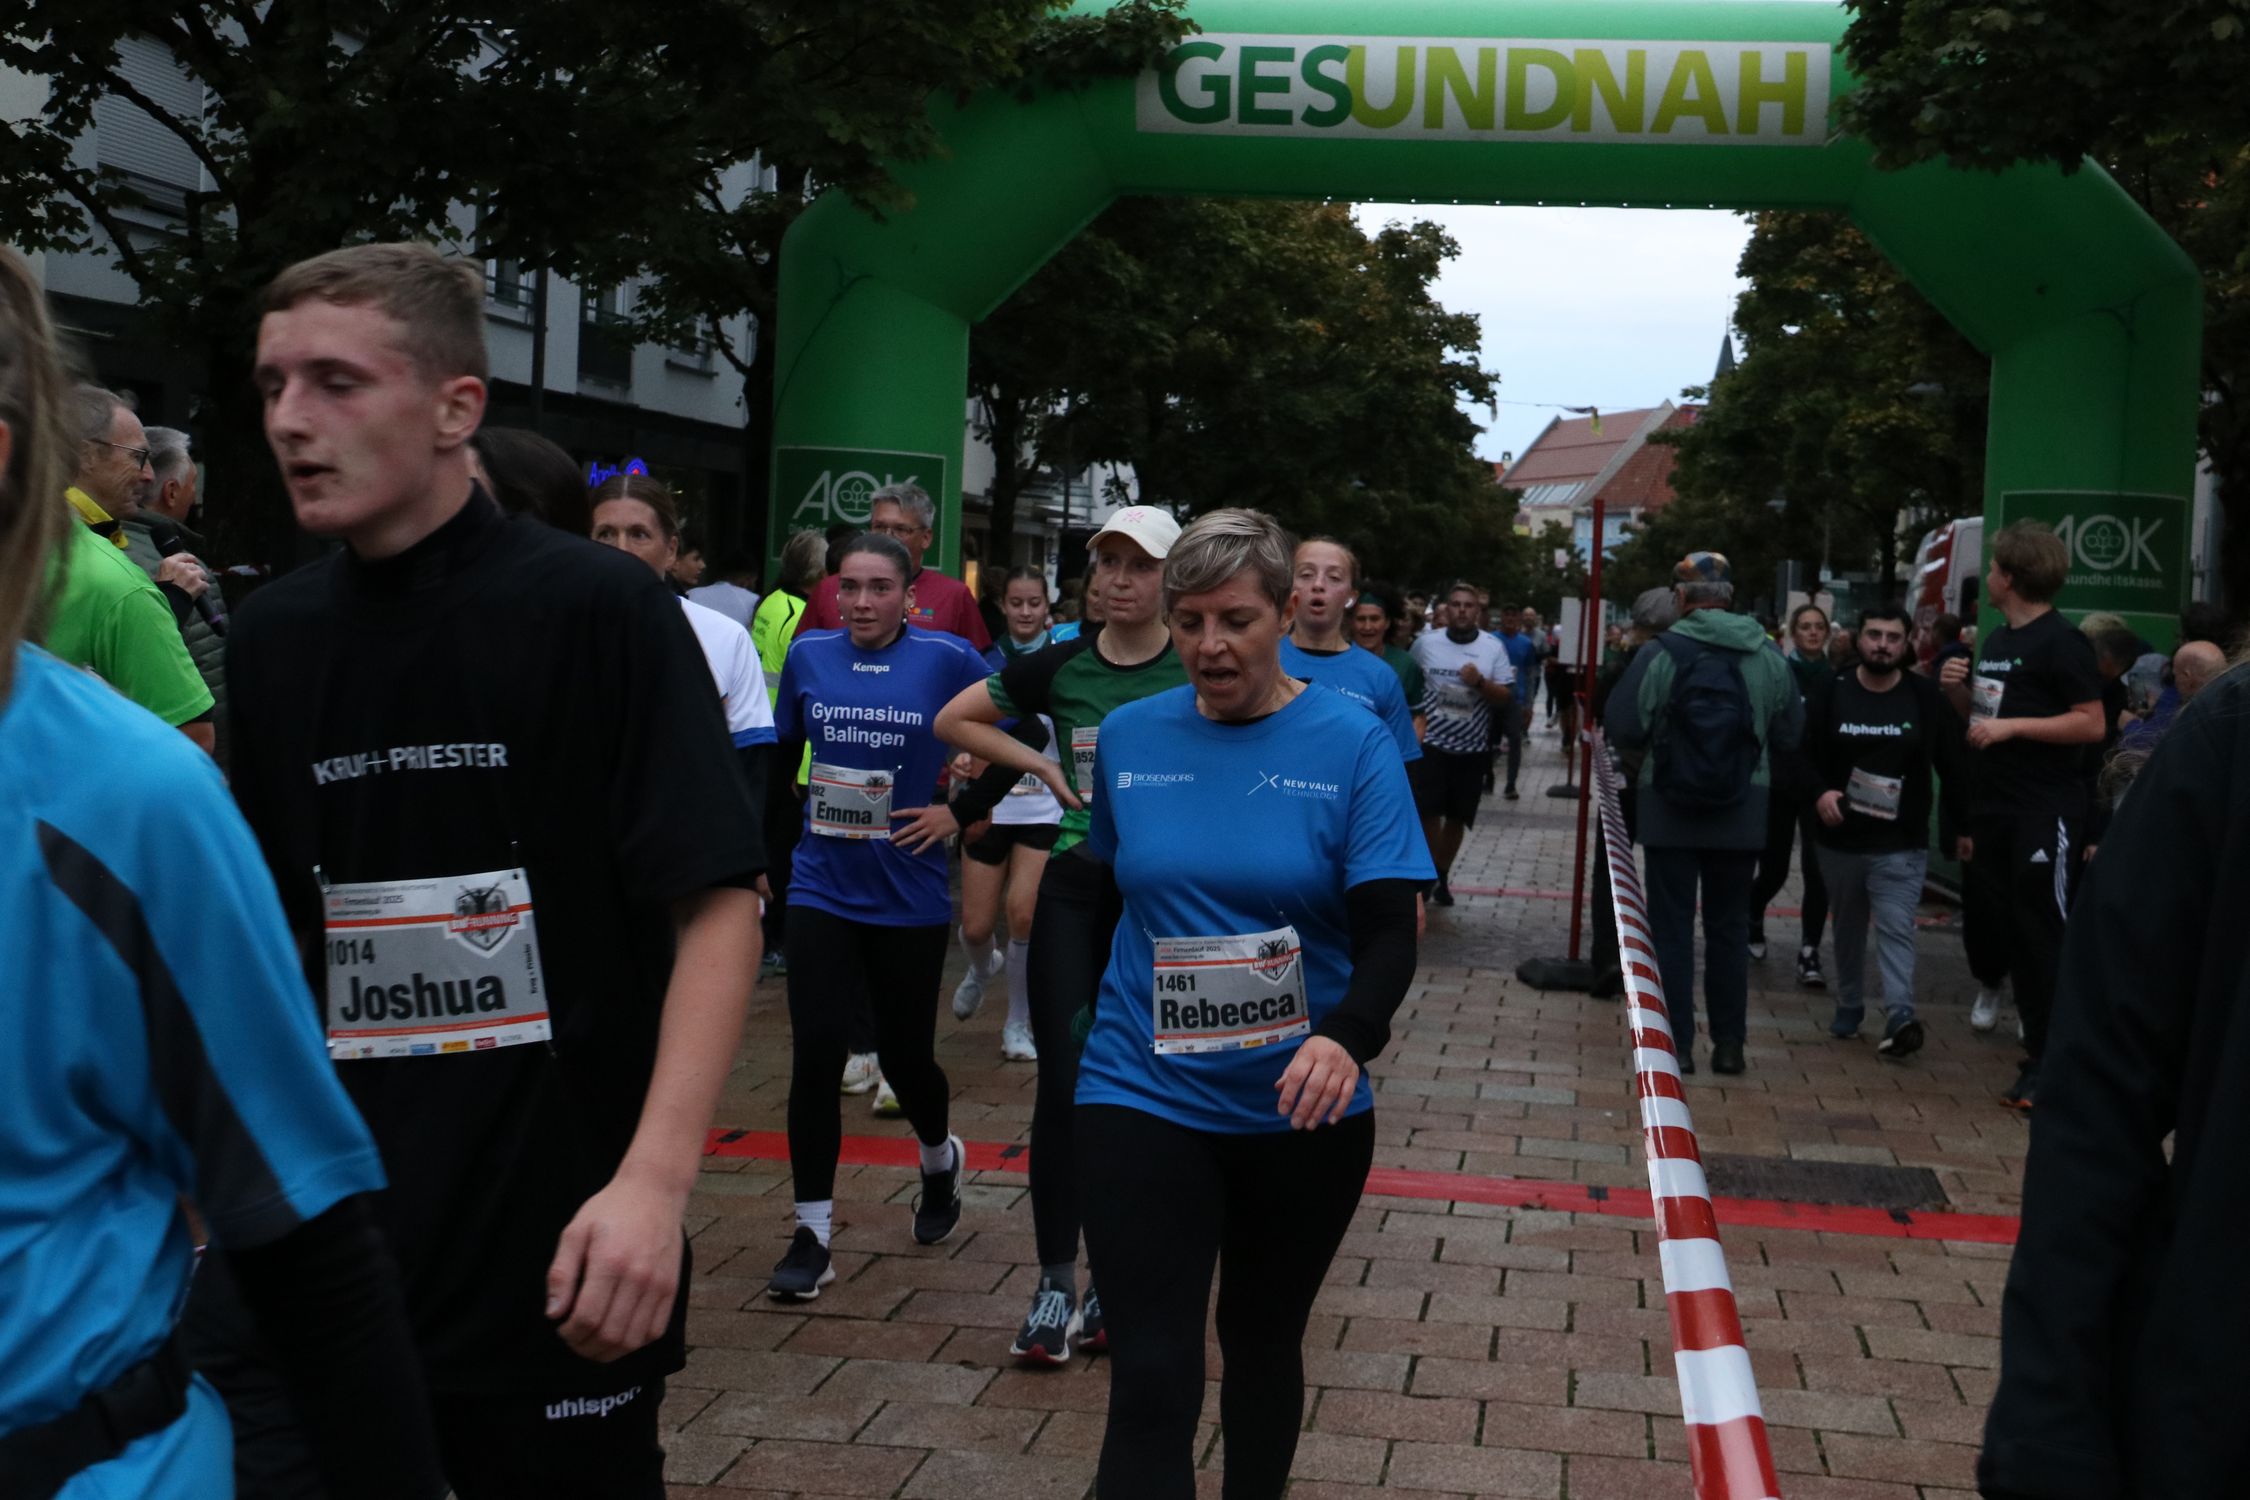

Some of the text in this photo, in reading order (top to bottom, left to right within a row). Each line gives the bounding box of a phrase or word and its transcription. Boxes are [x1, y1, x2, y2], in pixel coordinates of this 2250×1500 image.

[1159, 41, 1807, 135] GESUNDNAH
[792, 470, 919, 524] AO
[852, 662, 890, 674] Kempa
[812, 702, 922, 725] Gymnasium
[823, 725, 905, 748] Balingen
[1839, 722, 1902, 736] Alphartis
[1020, 775, 1036, 787] ah
[1133, 773, 1194, 782] BIOSENSORS
[1283, 778, 1339, 793] NEW VALVE
[816, 801, 873, 825] Emma
[326, 939, 375, 965] 1014
[1157, 974, 1195, 991] 1461
[340, 973, 506, 1022] Joshua
[1160, 993, 1296, 1029] Rebecca
[545, 1385, 642, 1419] uhlspor
